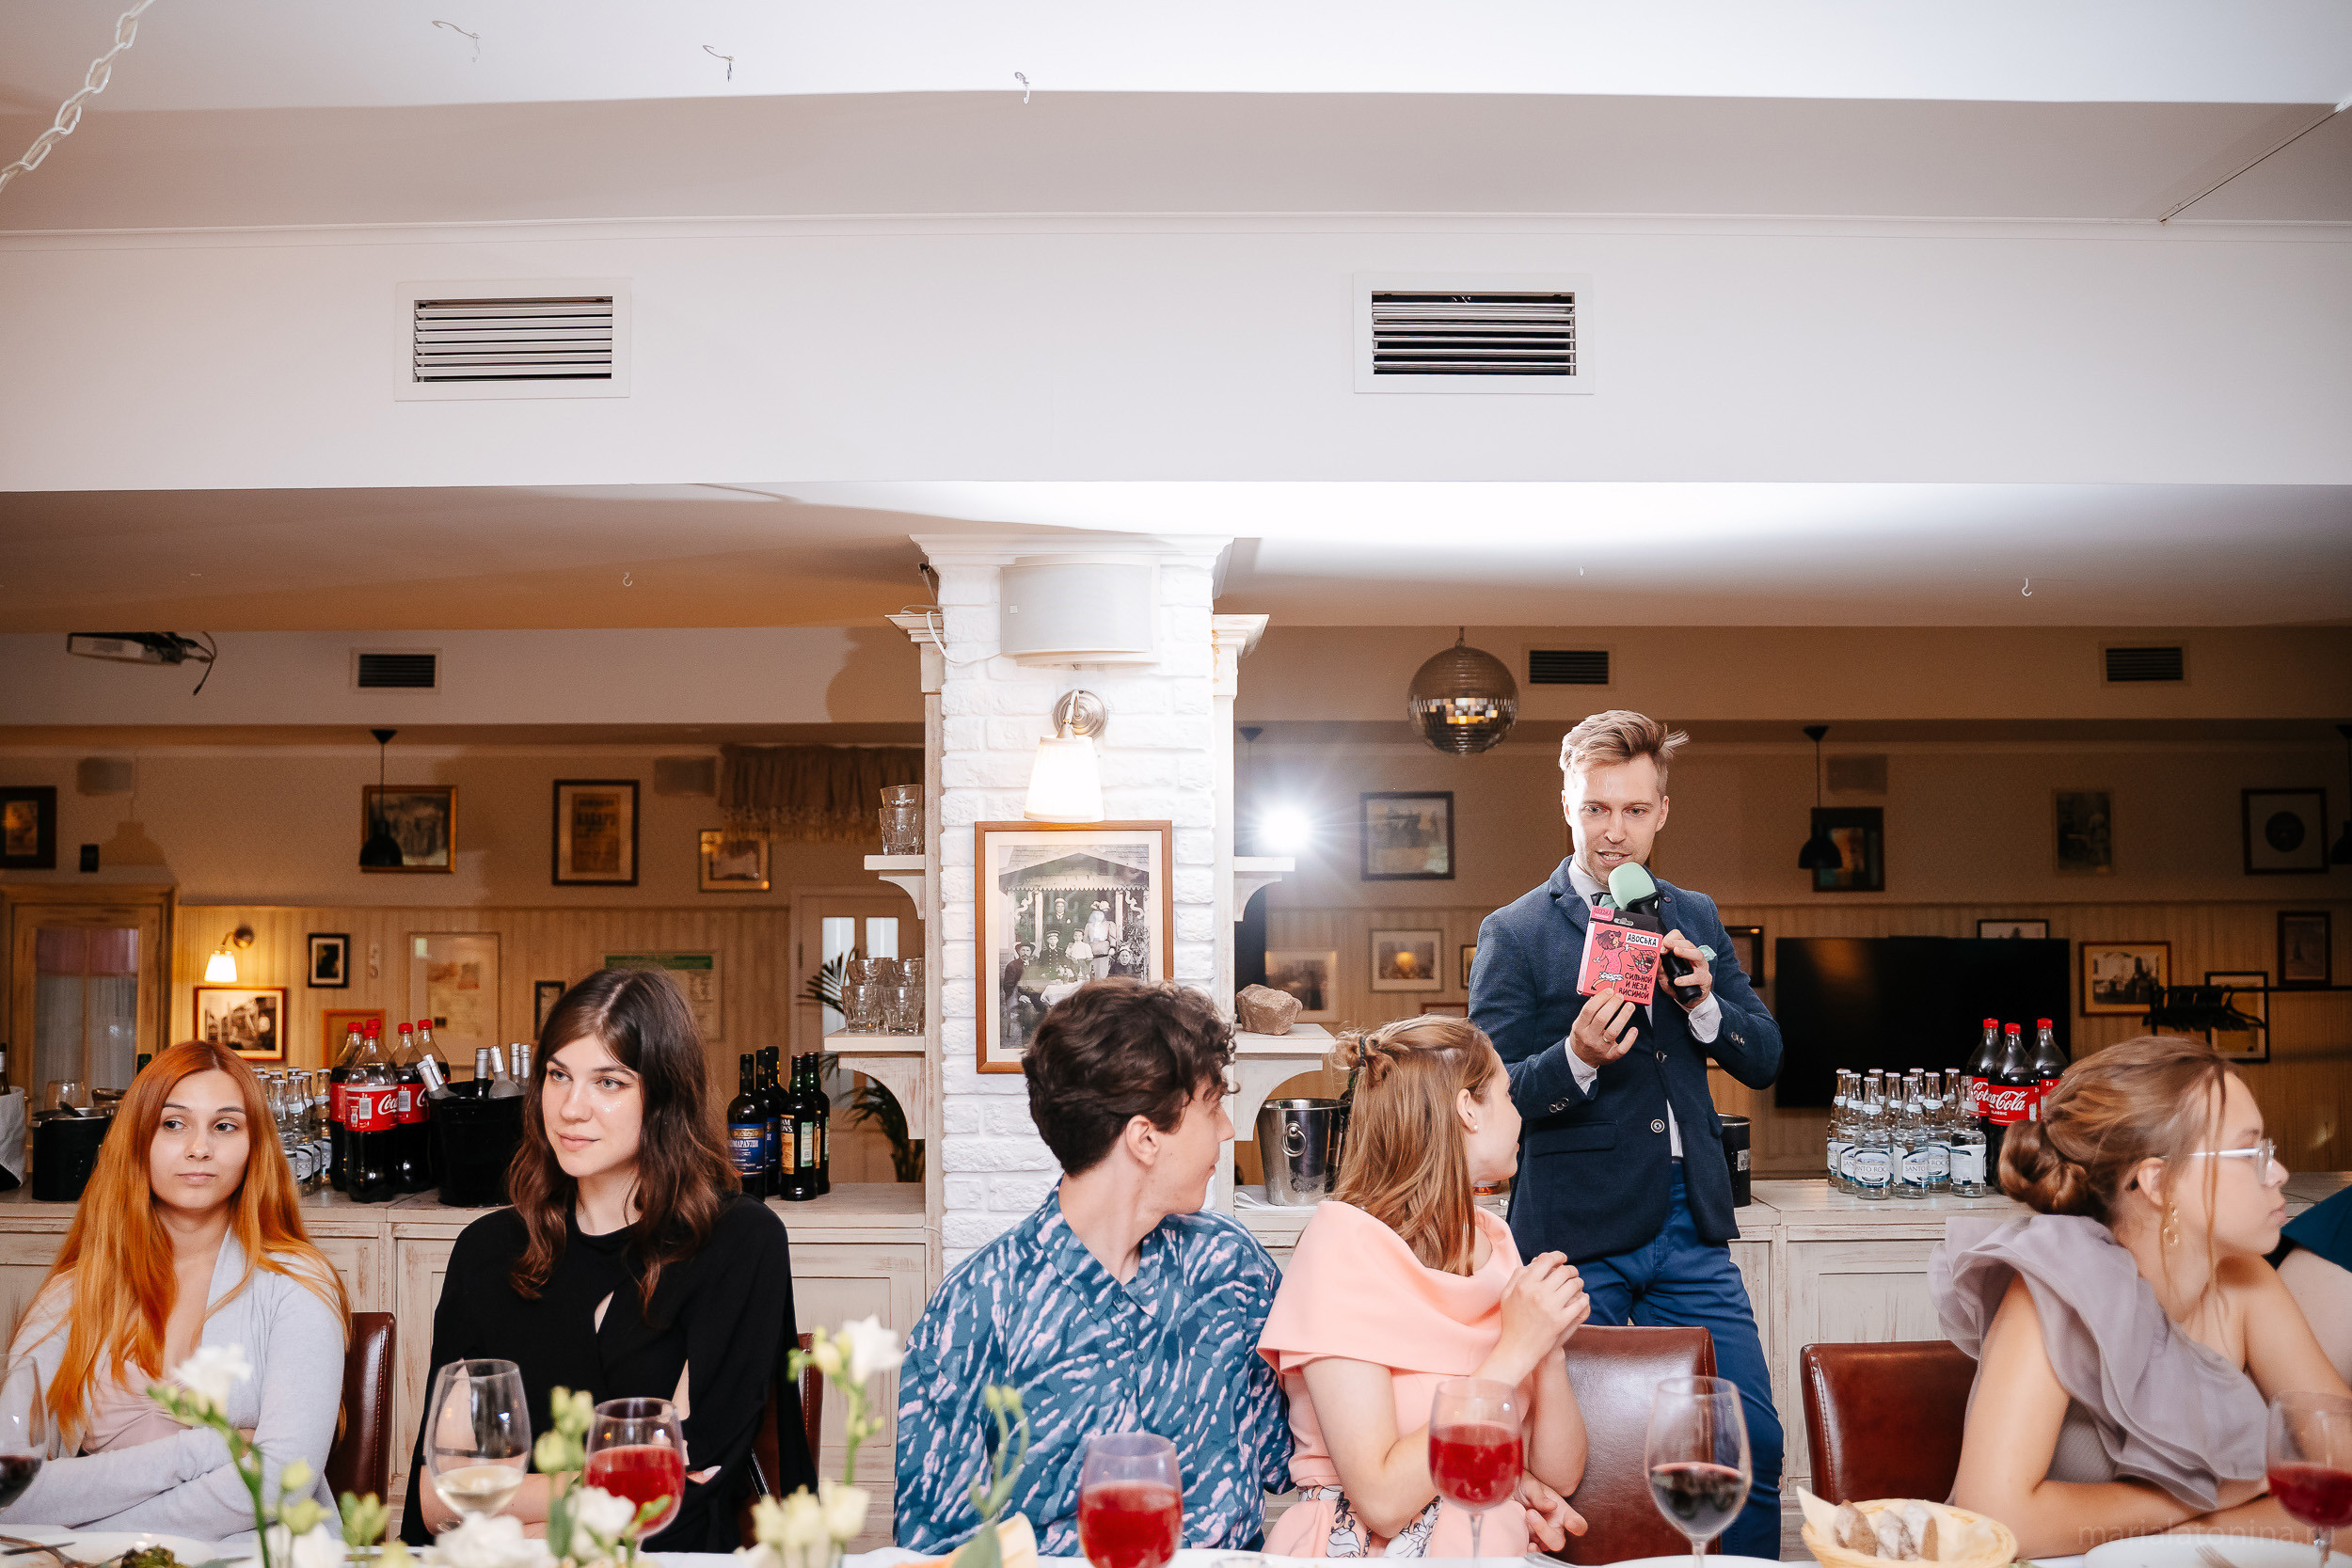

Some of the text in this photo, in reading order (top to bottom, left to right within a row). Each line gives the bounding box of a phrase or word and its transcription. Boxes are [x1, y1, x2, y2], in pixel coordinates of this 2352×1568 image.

[1627, 933, 1657, 946] АВОСЬКА
[1624, 972, 1653, 984] СИЛЬНОЙ
[1618, 987, 1650, 1001] ВИСИМОЙ
